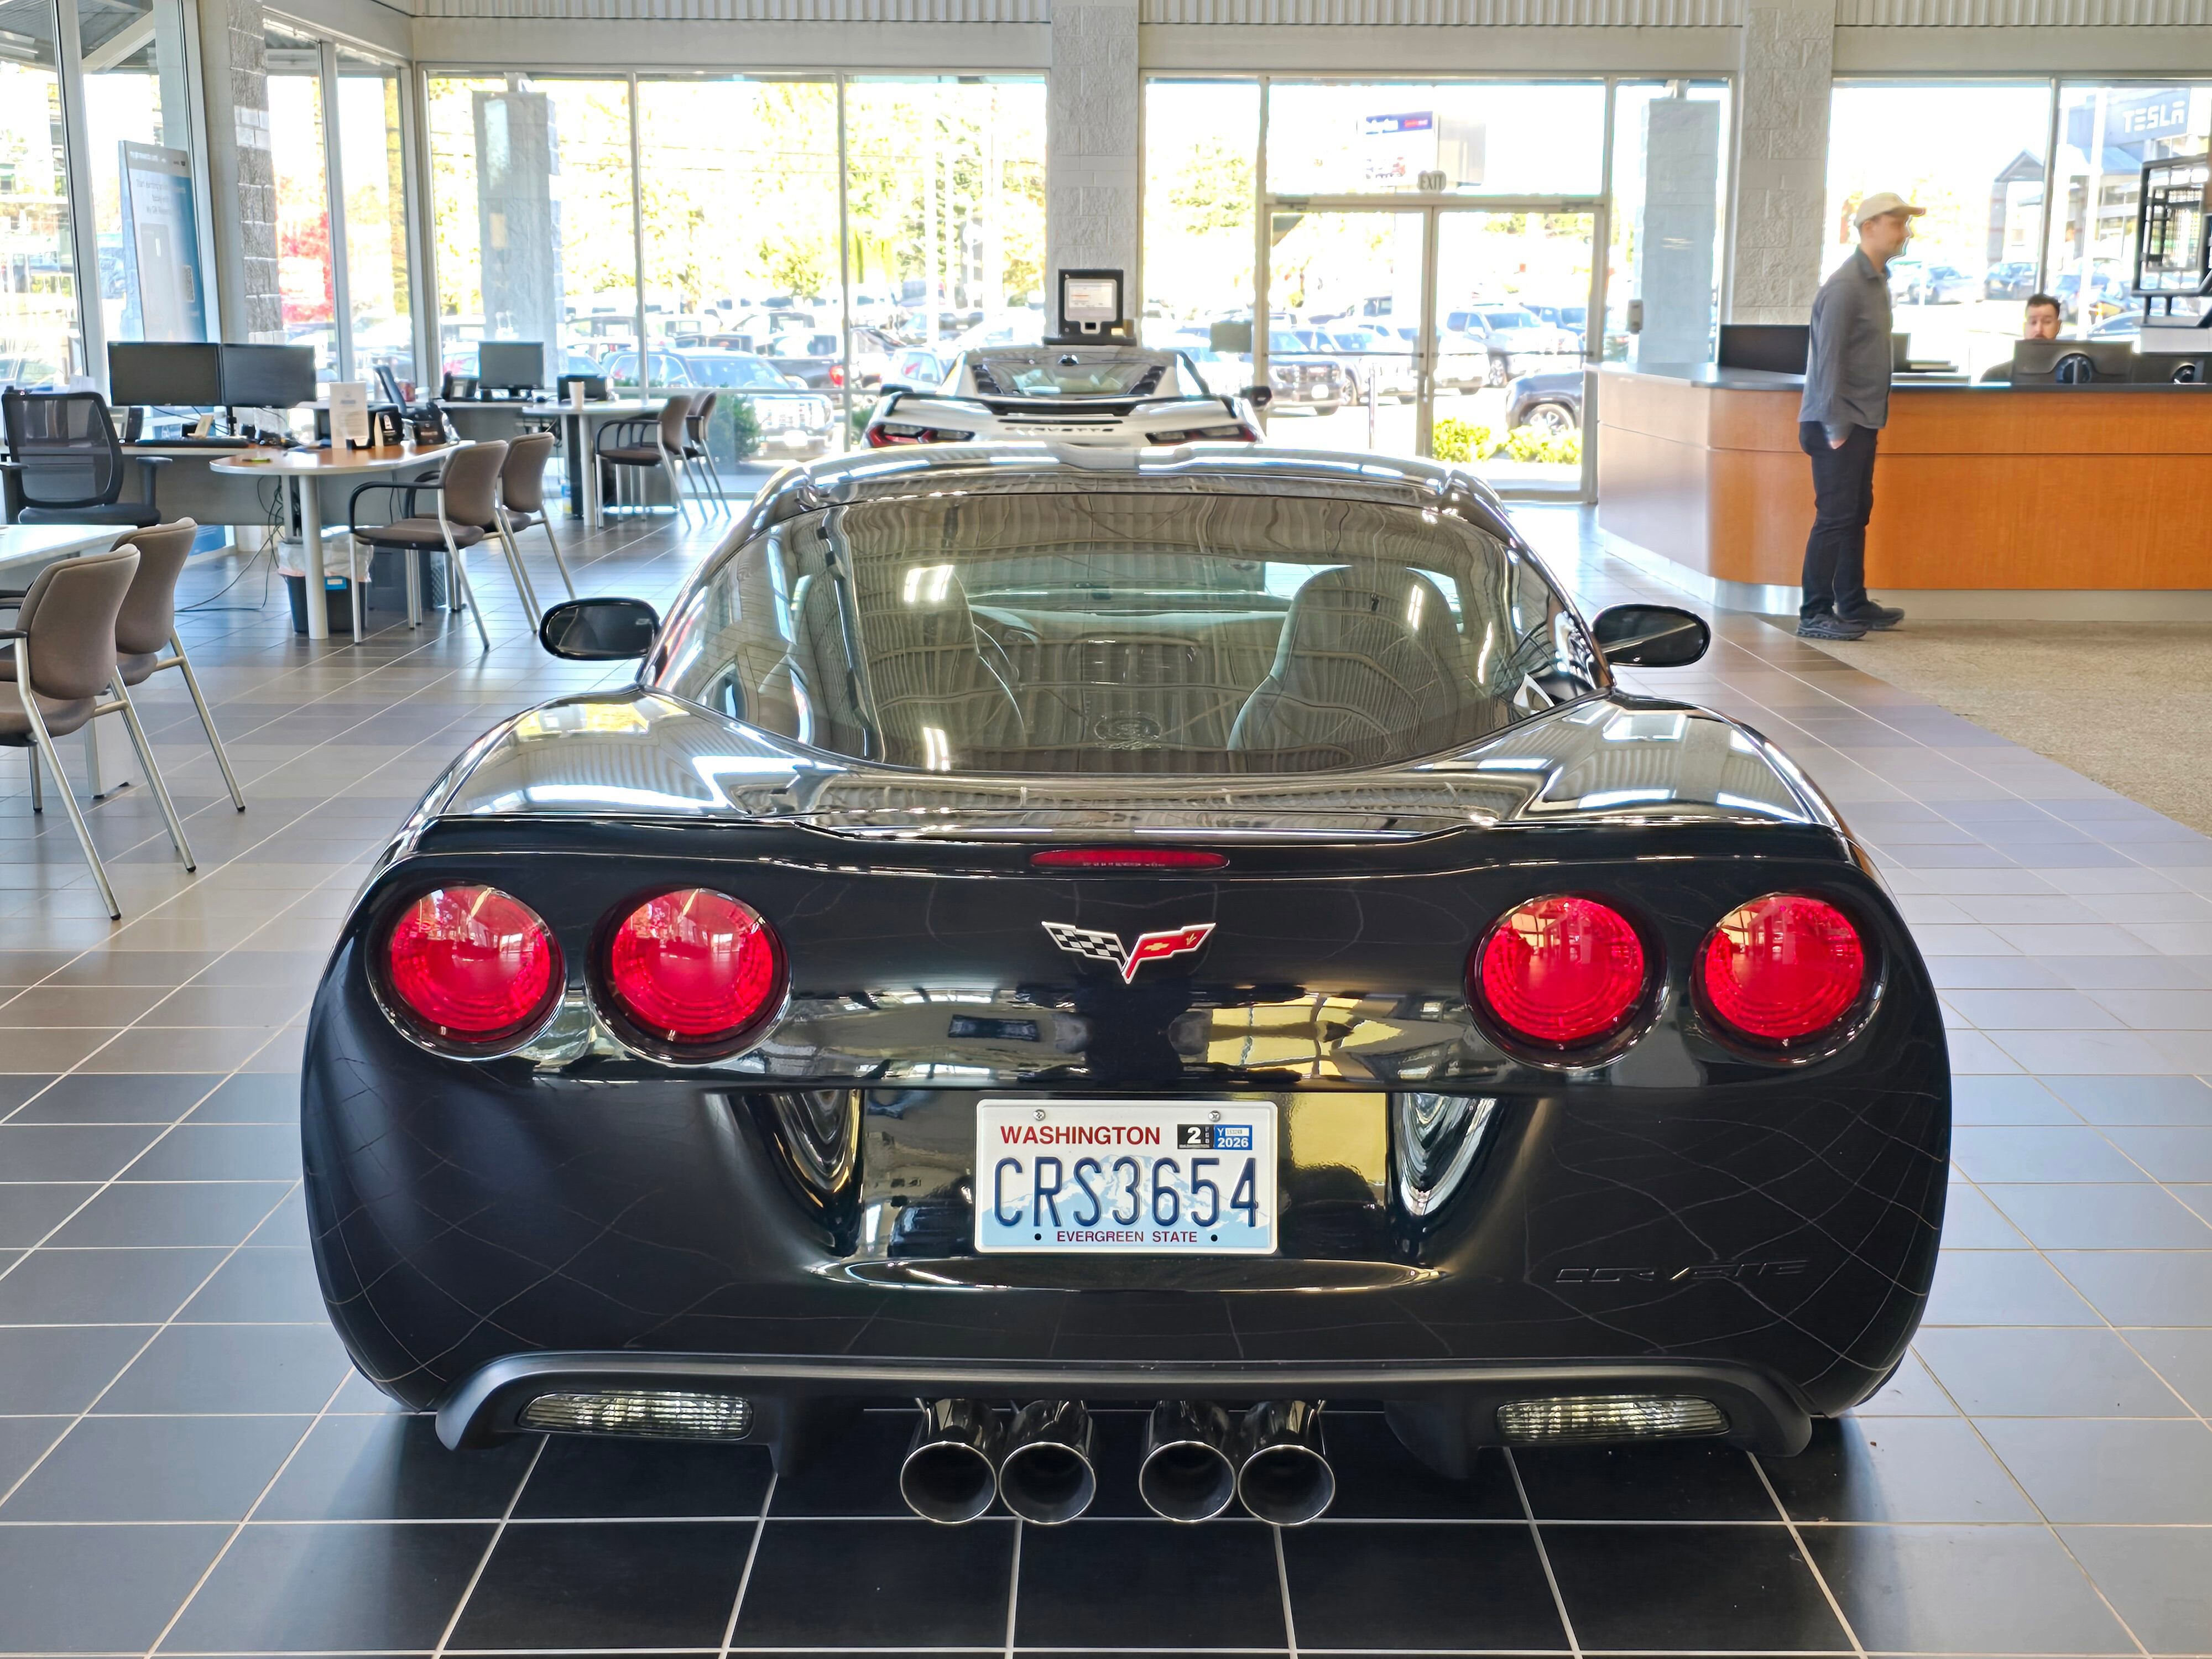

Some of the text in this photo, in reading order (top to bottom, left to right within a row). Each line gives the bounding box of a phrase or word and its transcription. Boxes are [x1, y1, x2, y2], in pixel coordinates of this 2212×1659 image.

[2123, 101, 2185, 133] TESLA
[1420, 174, 1443, 190] EXIT
[1000, 1125, 1160, 1145] WASHINGTON
[1187, 1126, 1202, 1144] 2
[1217, 1137, 1249, 1148] 2026
[995, 1156, 1259, 1228] CRS3654
[1056, 1230, 1198, 1243] EVERGREEN STATE
